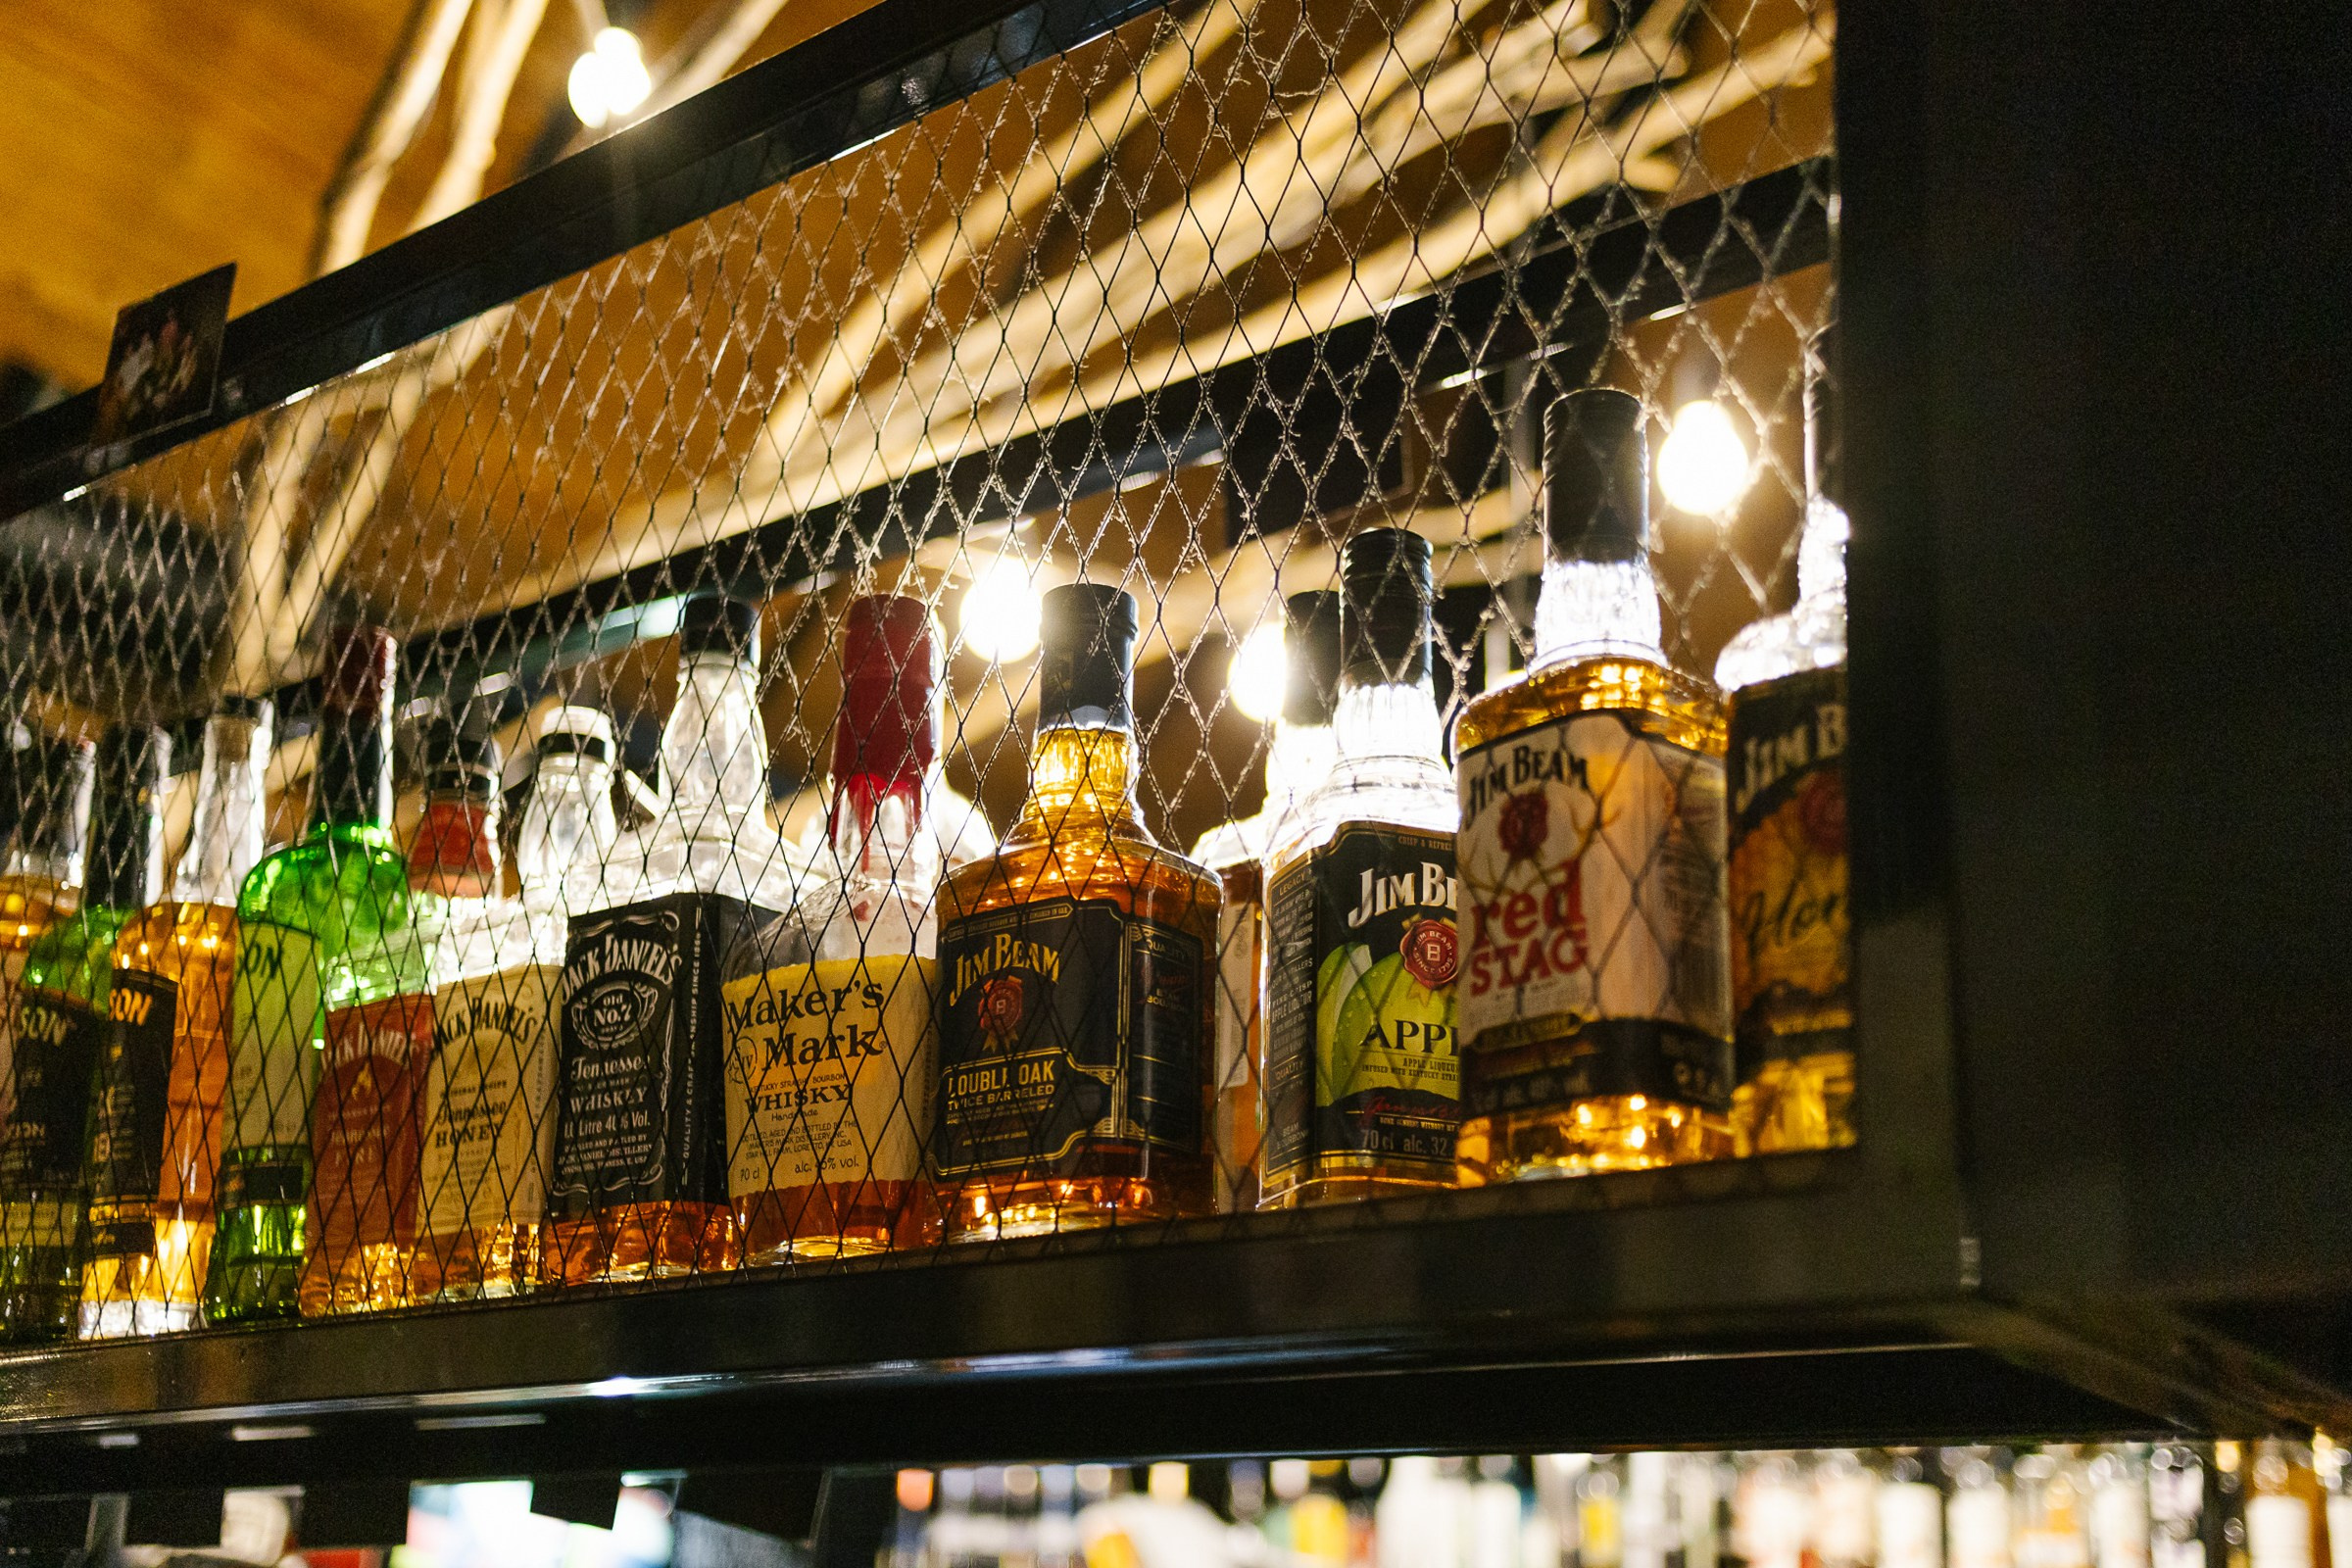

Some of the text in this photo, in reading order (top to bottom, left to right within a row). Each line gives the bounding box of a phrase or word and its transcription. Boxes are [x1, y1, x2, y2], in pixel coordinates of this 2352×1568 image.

[1465, 745, 1589, 831] JIM BEAM
[1348, 867, 1416, 929] JIM
[1471, 856, 1586, 949] red
[1427, 944, 1441, 961] B
[1430, 931, 1452, 951] BEAM
[605, 933, 682, 986] DANIEL'S
[949, 933, 1059, 1007] JIM BEAM
[1470, 928, 1588, 997] STAG
[1290, 980, 1313, 998] CISP
[727, 980, 885, 1034] Maker's
[761, 1024, 884, 1071] Mark
[1018, 1059, 1055, 1085] OAK
[745, 1084, 852, 1114] WHISKY
[578, 1116, 603, 1138] Litre
[631, 1109, 651, 1130] Vol.
[836, 1139, 853, 1148] USA
[1360, 1129, 1379, 1150] 70
[1403, 1134, 1427, 1154] alc.
[795, 1160, 812, 1174] alc.
[840, 1154, 859, 1168] vol.
